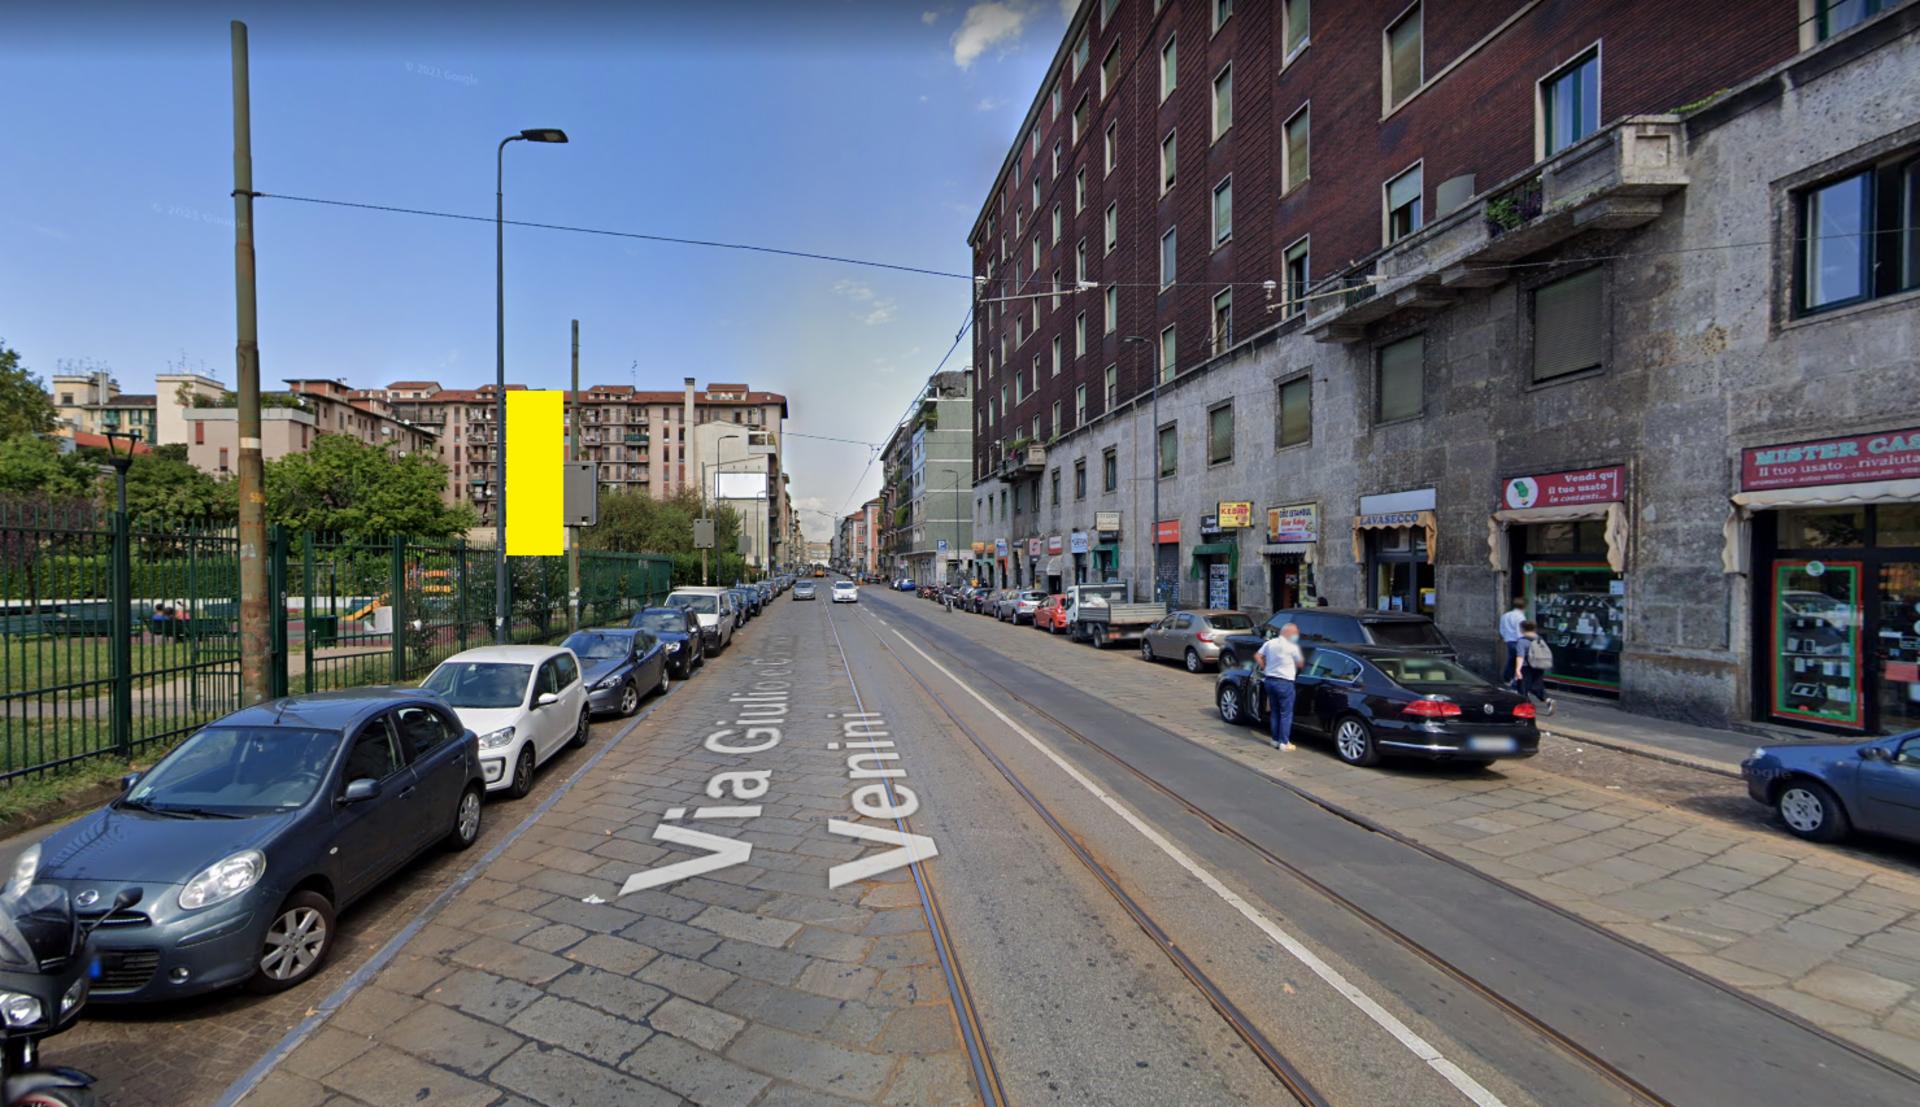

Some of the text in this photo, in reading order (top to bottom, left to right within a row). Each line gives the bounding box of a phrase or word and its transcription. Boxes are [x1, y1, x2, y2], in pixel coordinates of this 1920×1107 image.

[1755, 442, 1858, 465] MISTER
[1773, 465, 1796, 475] tuo
[1565, 472, 1596, 482] Vendi
[1558, 486, 1575, 494] tuo
[1578, 483, 1607, 492] usato
[1360, 513, 1419, 526] LAVASECCO
